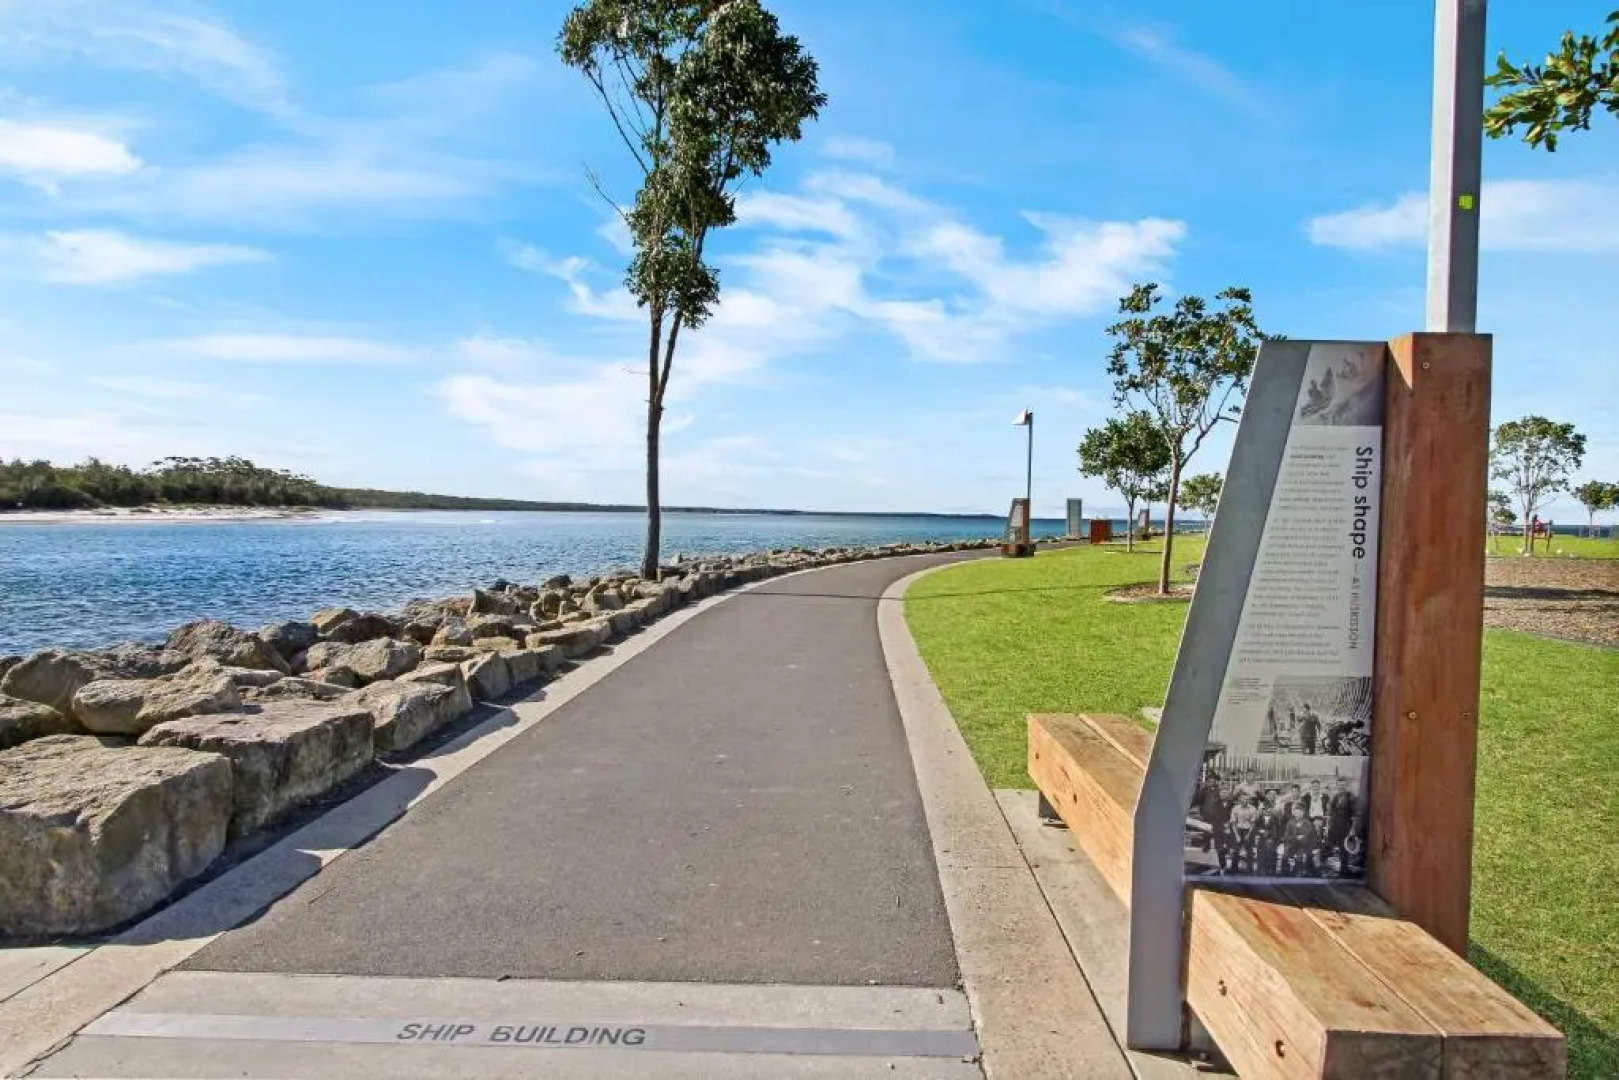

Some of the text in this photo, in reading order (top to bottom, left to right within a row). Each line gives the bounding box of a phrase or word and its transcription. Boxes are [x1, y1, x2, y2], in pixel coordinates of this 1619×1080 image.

[1351, 446, 1374, 489] Ship
[1348, 496, 1371, 559] shape
[397, 1022, 646, 1046] SHIP BUILDING
